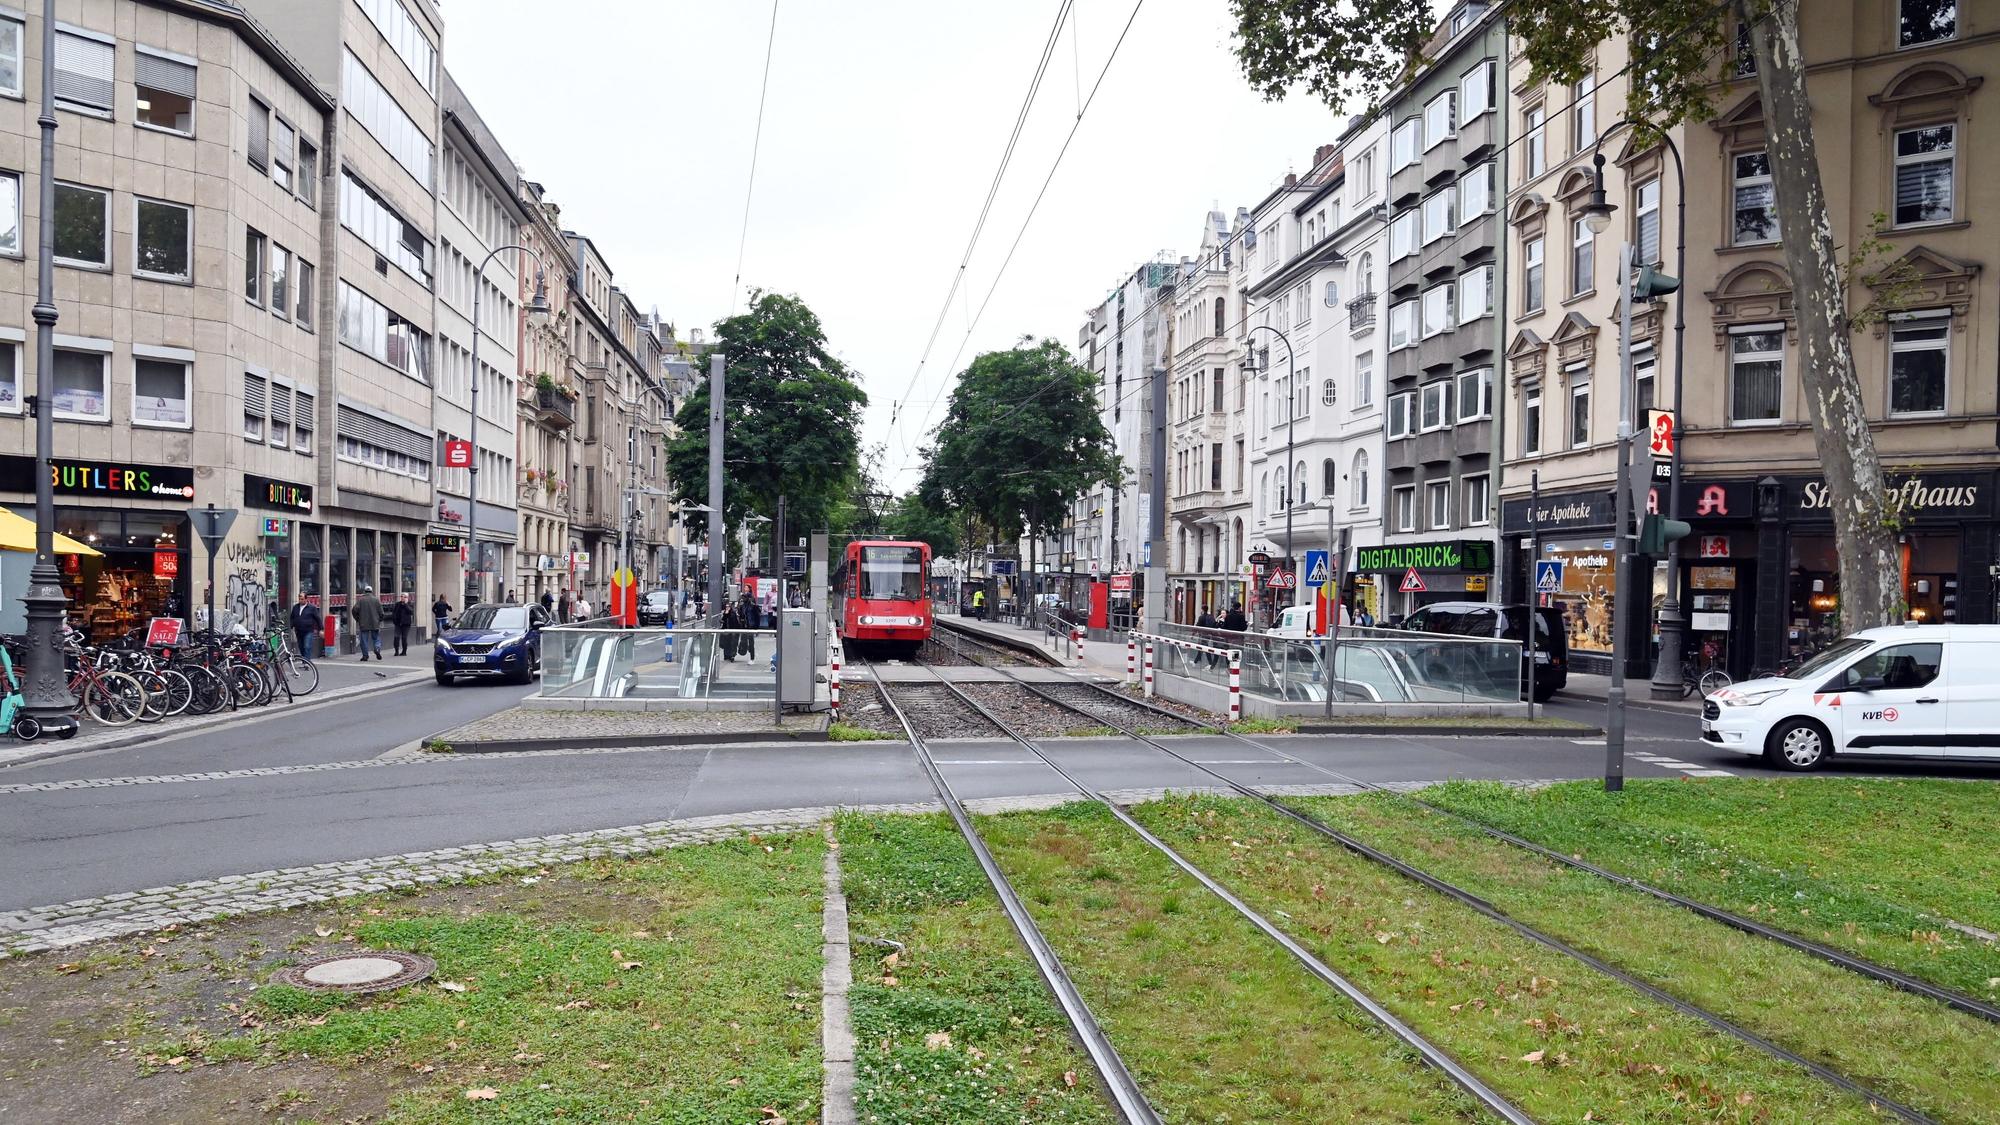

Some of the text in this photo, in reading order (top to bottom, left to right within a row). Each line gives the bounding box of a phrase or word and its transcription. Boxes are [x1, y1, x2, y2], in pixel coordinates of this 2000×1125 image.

[52, 466, 150, 492] BUTLERS
[269, 484, 300, 506] BUTLERS
[1527, 502, 1591, 524] Uier Apotheke
[426, 537, 457, 546] BUTLERS
[1145, 544, 1151, 564] U
[1360, 545, 1451, 569] DIGITALDRUCK
[1573, 554, 1608, 570] Apotheke
[152, 632, 174, 640] SALE
[1862, 711, 1883, 720] KVB
